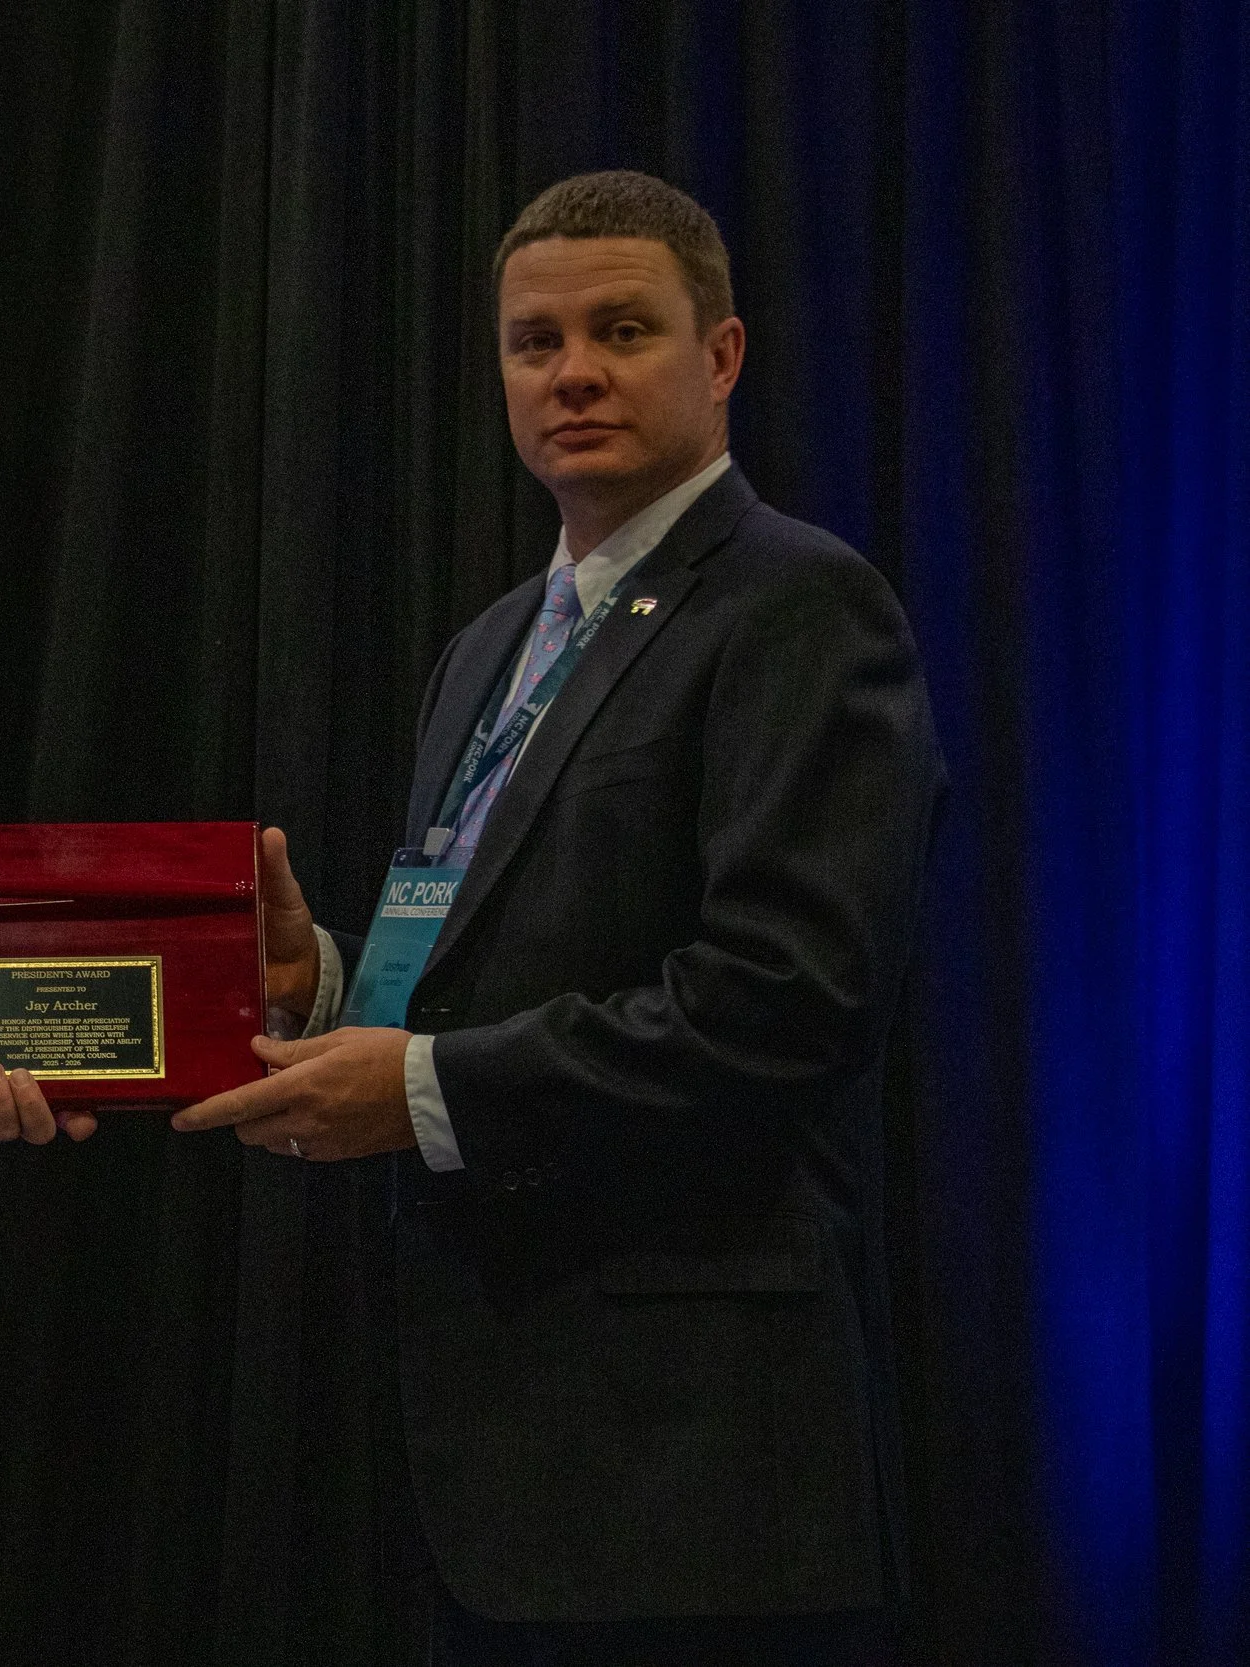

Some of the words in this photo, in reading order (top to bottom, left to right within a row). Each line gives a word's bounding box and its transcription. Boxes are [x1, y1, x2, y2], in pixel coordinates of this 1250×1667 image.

[597, 608, 609, 623] NC
[575, 622, 600, 649] PORK
[514, 715, 529, 730] NC
[494, 729, 518, 756] PORK
[474, 743, 484, 758] NC
[463, 758, 479, 783] PORK
[386, 881, 411, 904] NC
[411, 881, 459, 904] PORK
[410, 907, 448, 916] CONFERENC
[11, 970, 73, 979] PRESIDENT'S
[75, 970, 110, 978] AWARD
[25, 1000, 50, 1013] Jay
[53, 1000, 98, 1010] Archer
